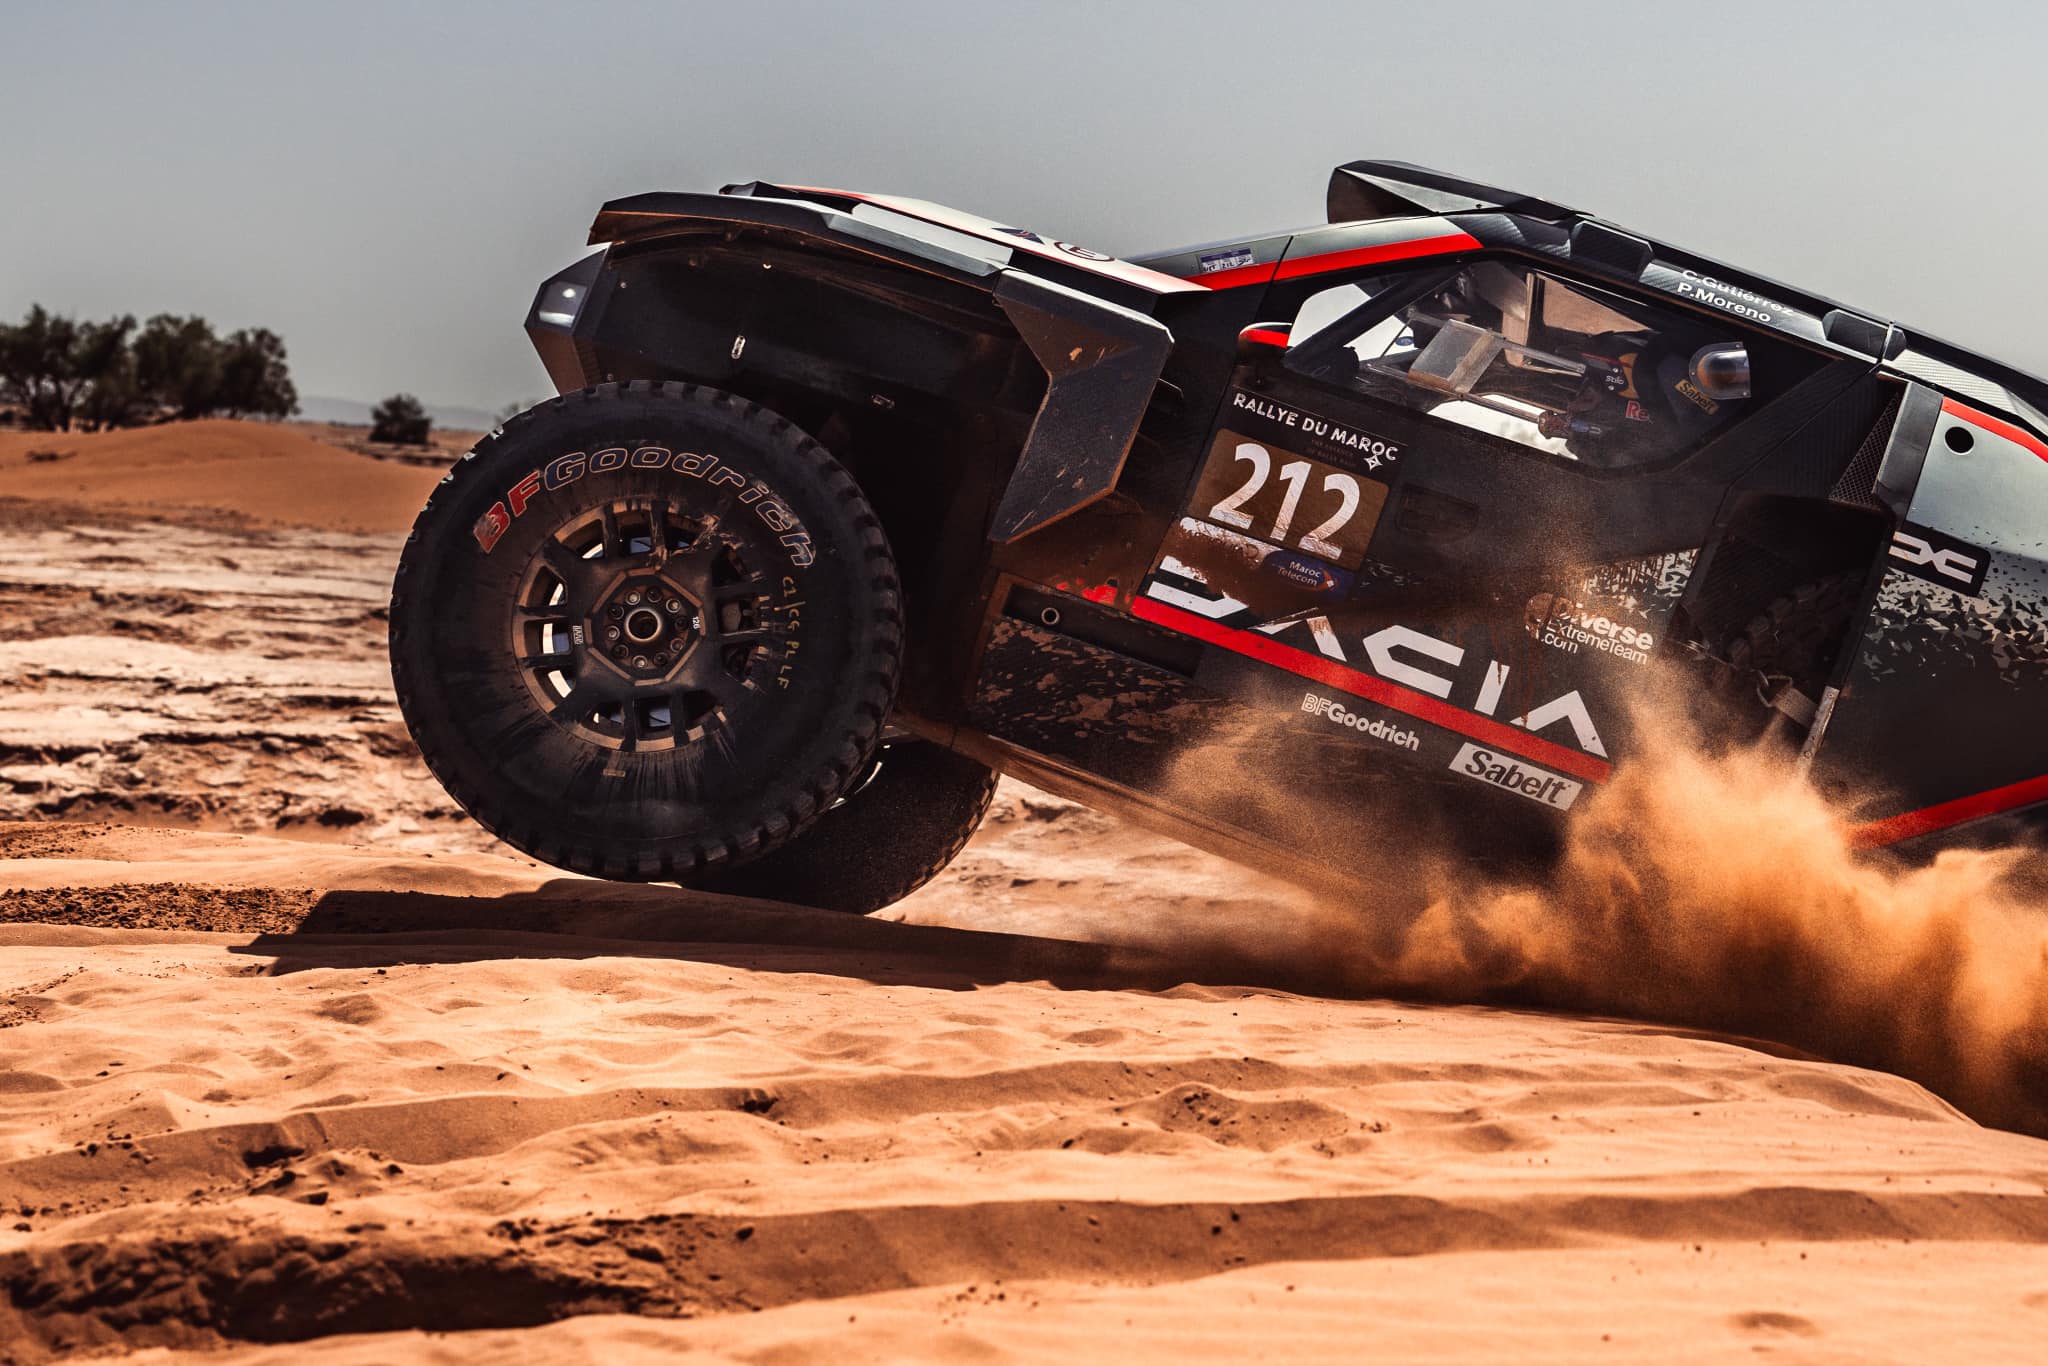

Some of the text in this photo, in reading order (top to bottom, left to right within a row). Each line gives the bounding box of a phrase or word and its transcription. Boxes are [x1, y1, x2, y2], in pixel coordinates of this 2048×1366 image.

[1677, 282, 1771, 322] P.Moreno
[1233, 392, 1299, 426] RALLYE
[1302, 417, 1328, 436] DU
[1331, 428, 1399, 461] MAROC
[1625, 400, 1650, 421] Re
[473, 447, 816, 566] BFGoodrich
[1208, 443, 1360, 560] 212
[1277, 566, 1318, 587] Telecom
[1289, 561, 1322, 578] Maroc
[1541, 632, 1579, 654] .com
[1546, 619, 1648, 665] ExtremeTeam
[1301, 693, 1420, 751] BFGoodrich
[1464, 749, 1567, 805] Sabelt
